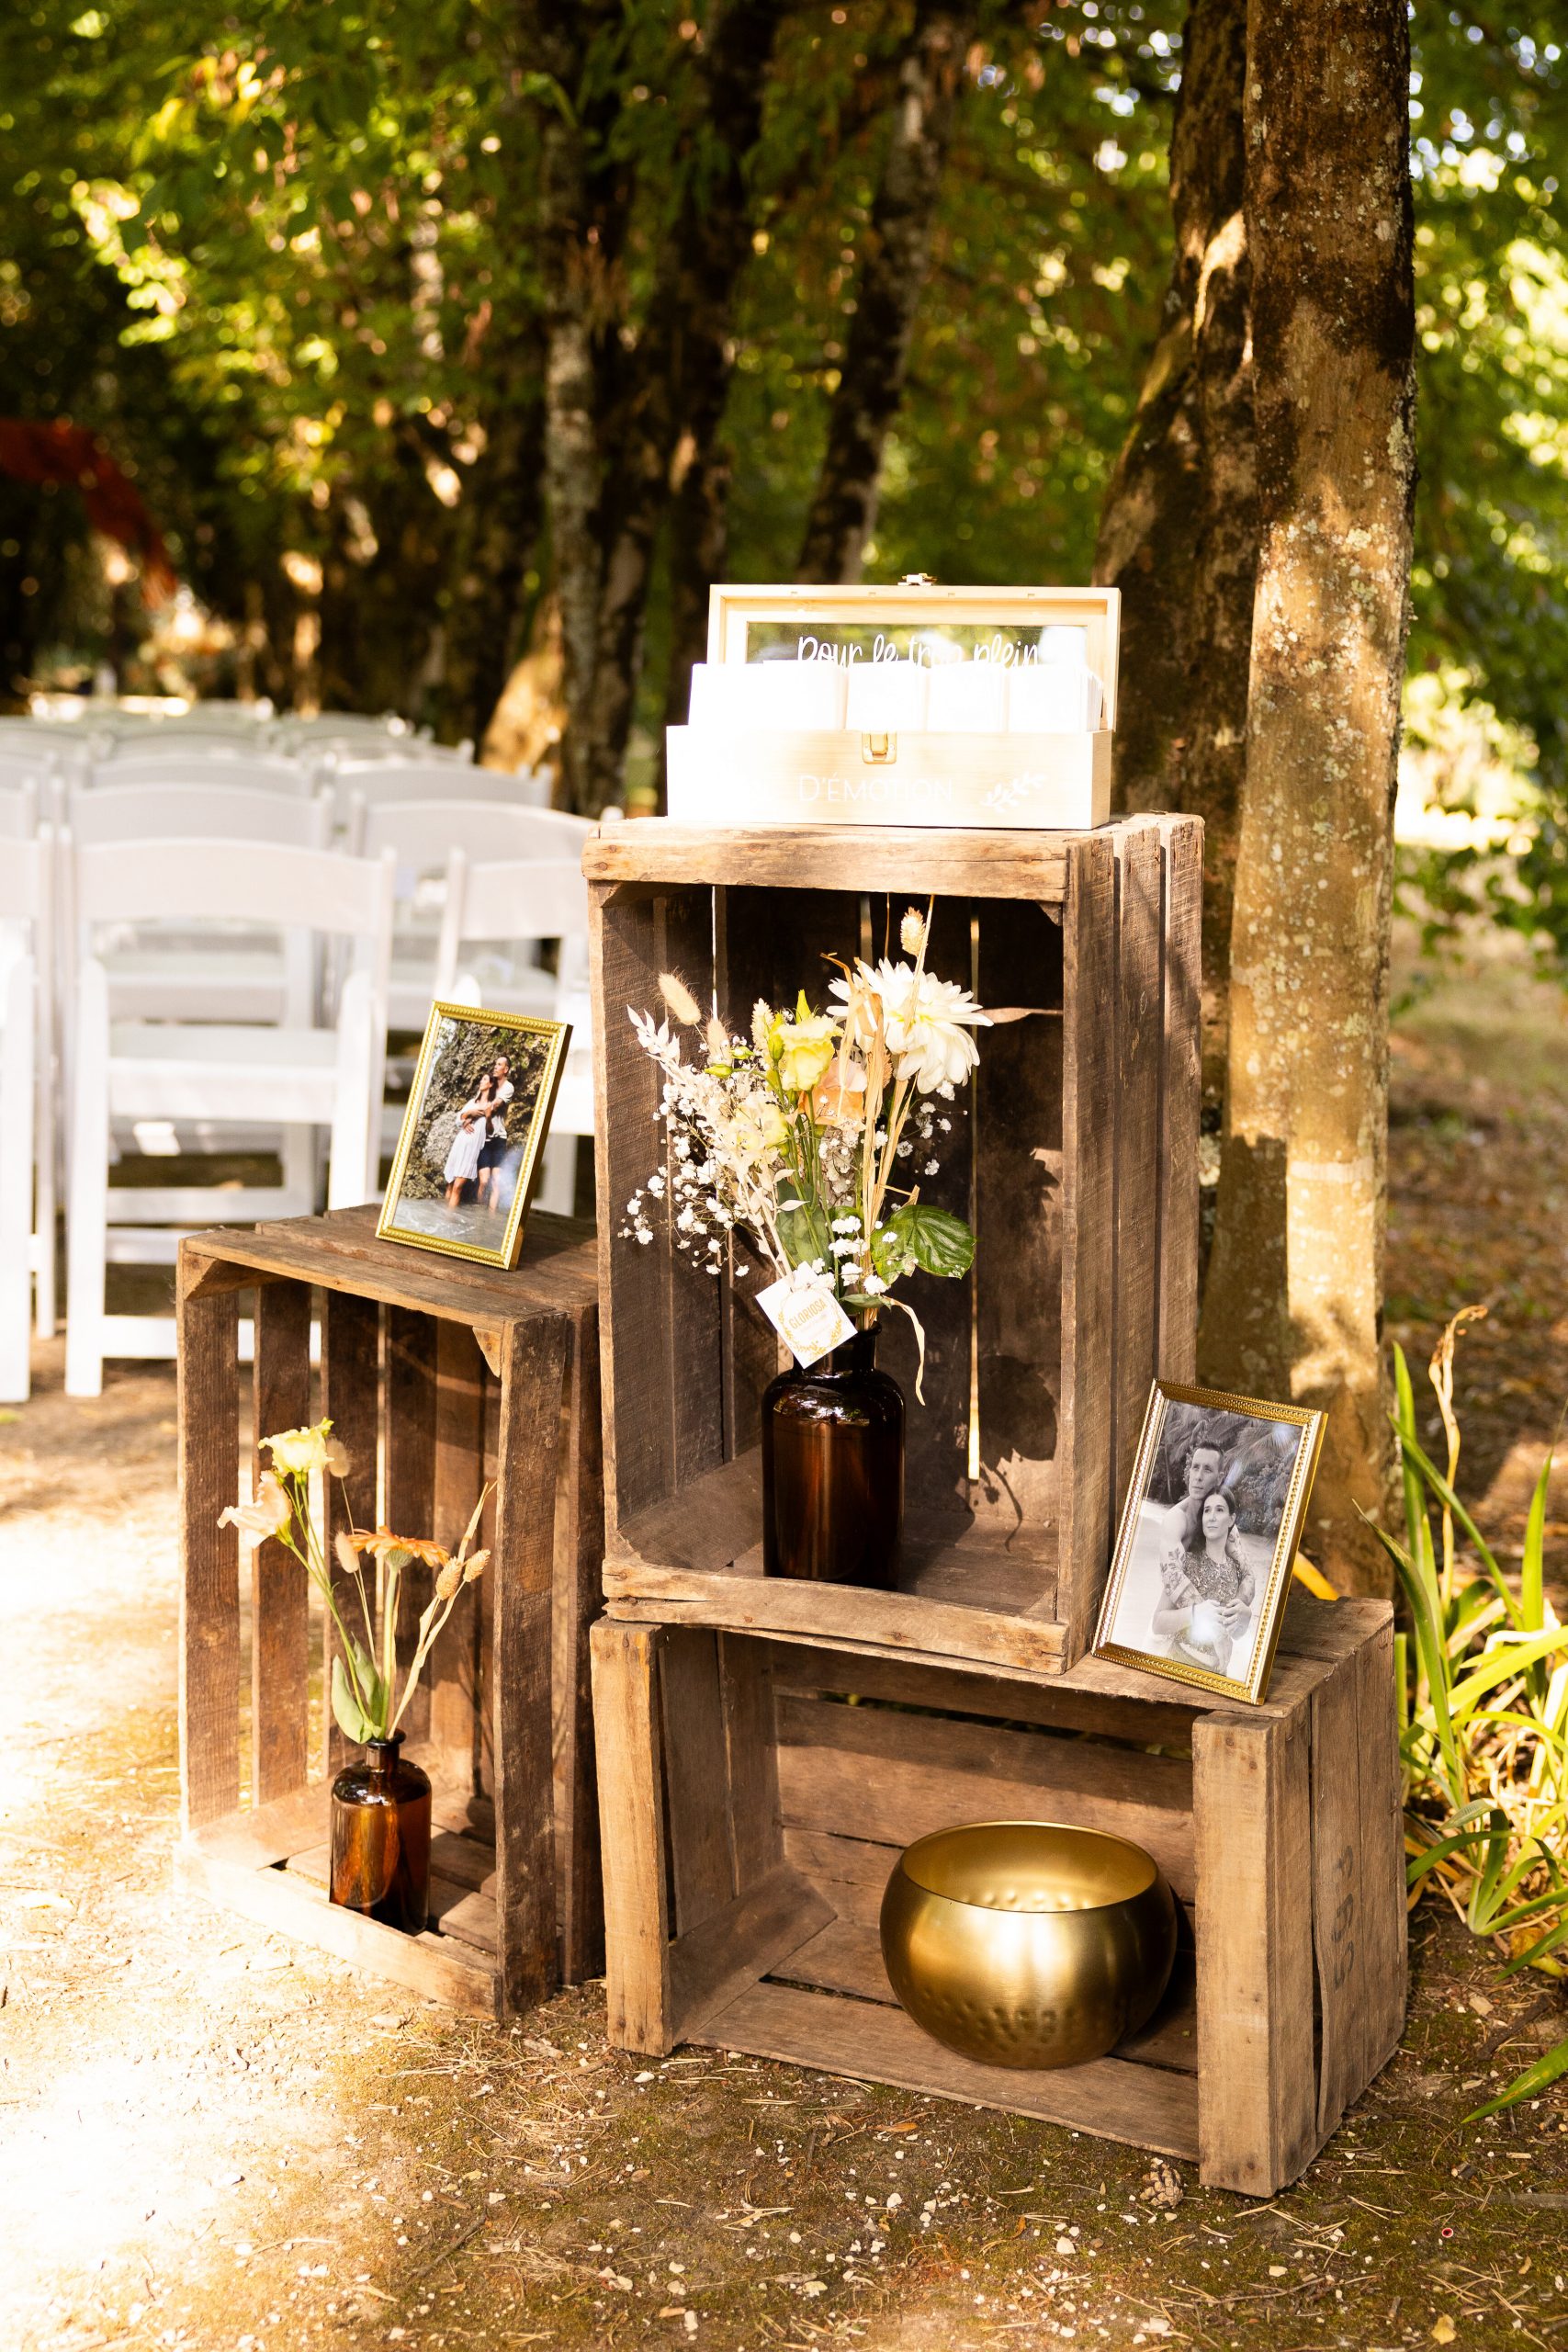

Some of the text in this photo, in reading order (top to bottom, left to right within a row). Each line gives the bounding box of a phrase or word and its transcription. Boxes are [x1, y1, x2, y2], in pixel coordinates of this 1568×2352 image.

[873, 634, 899, 663] le
[908, 635, 963, 668] trp
[788, 1297, 828, 1329] GLORIOSA
